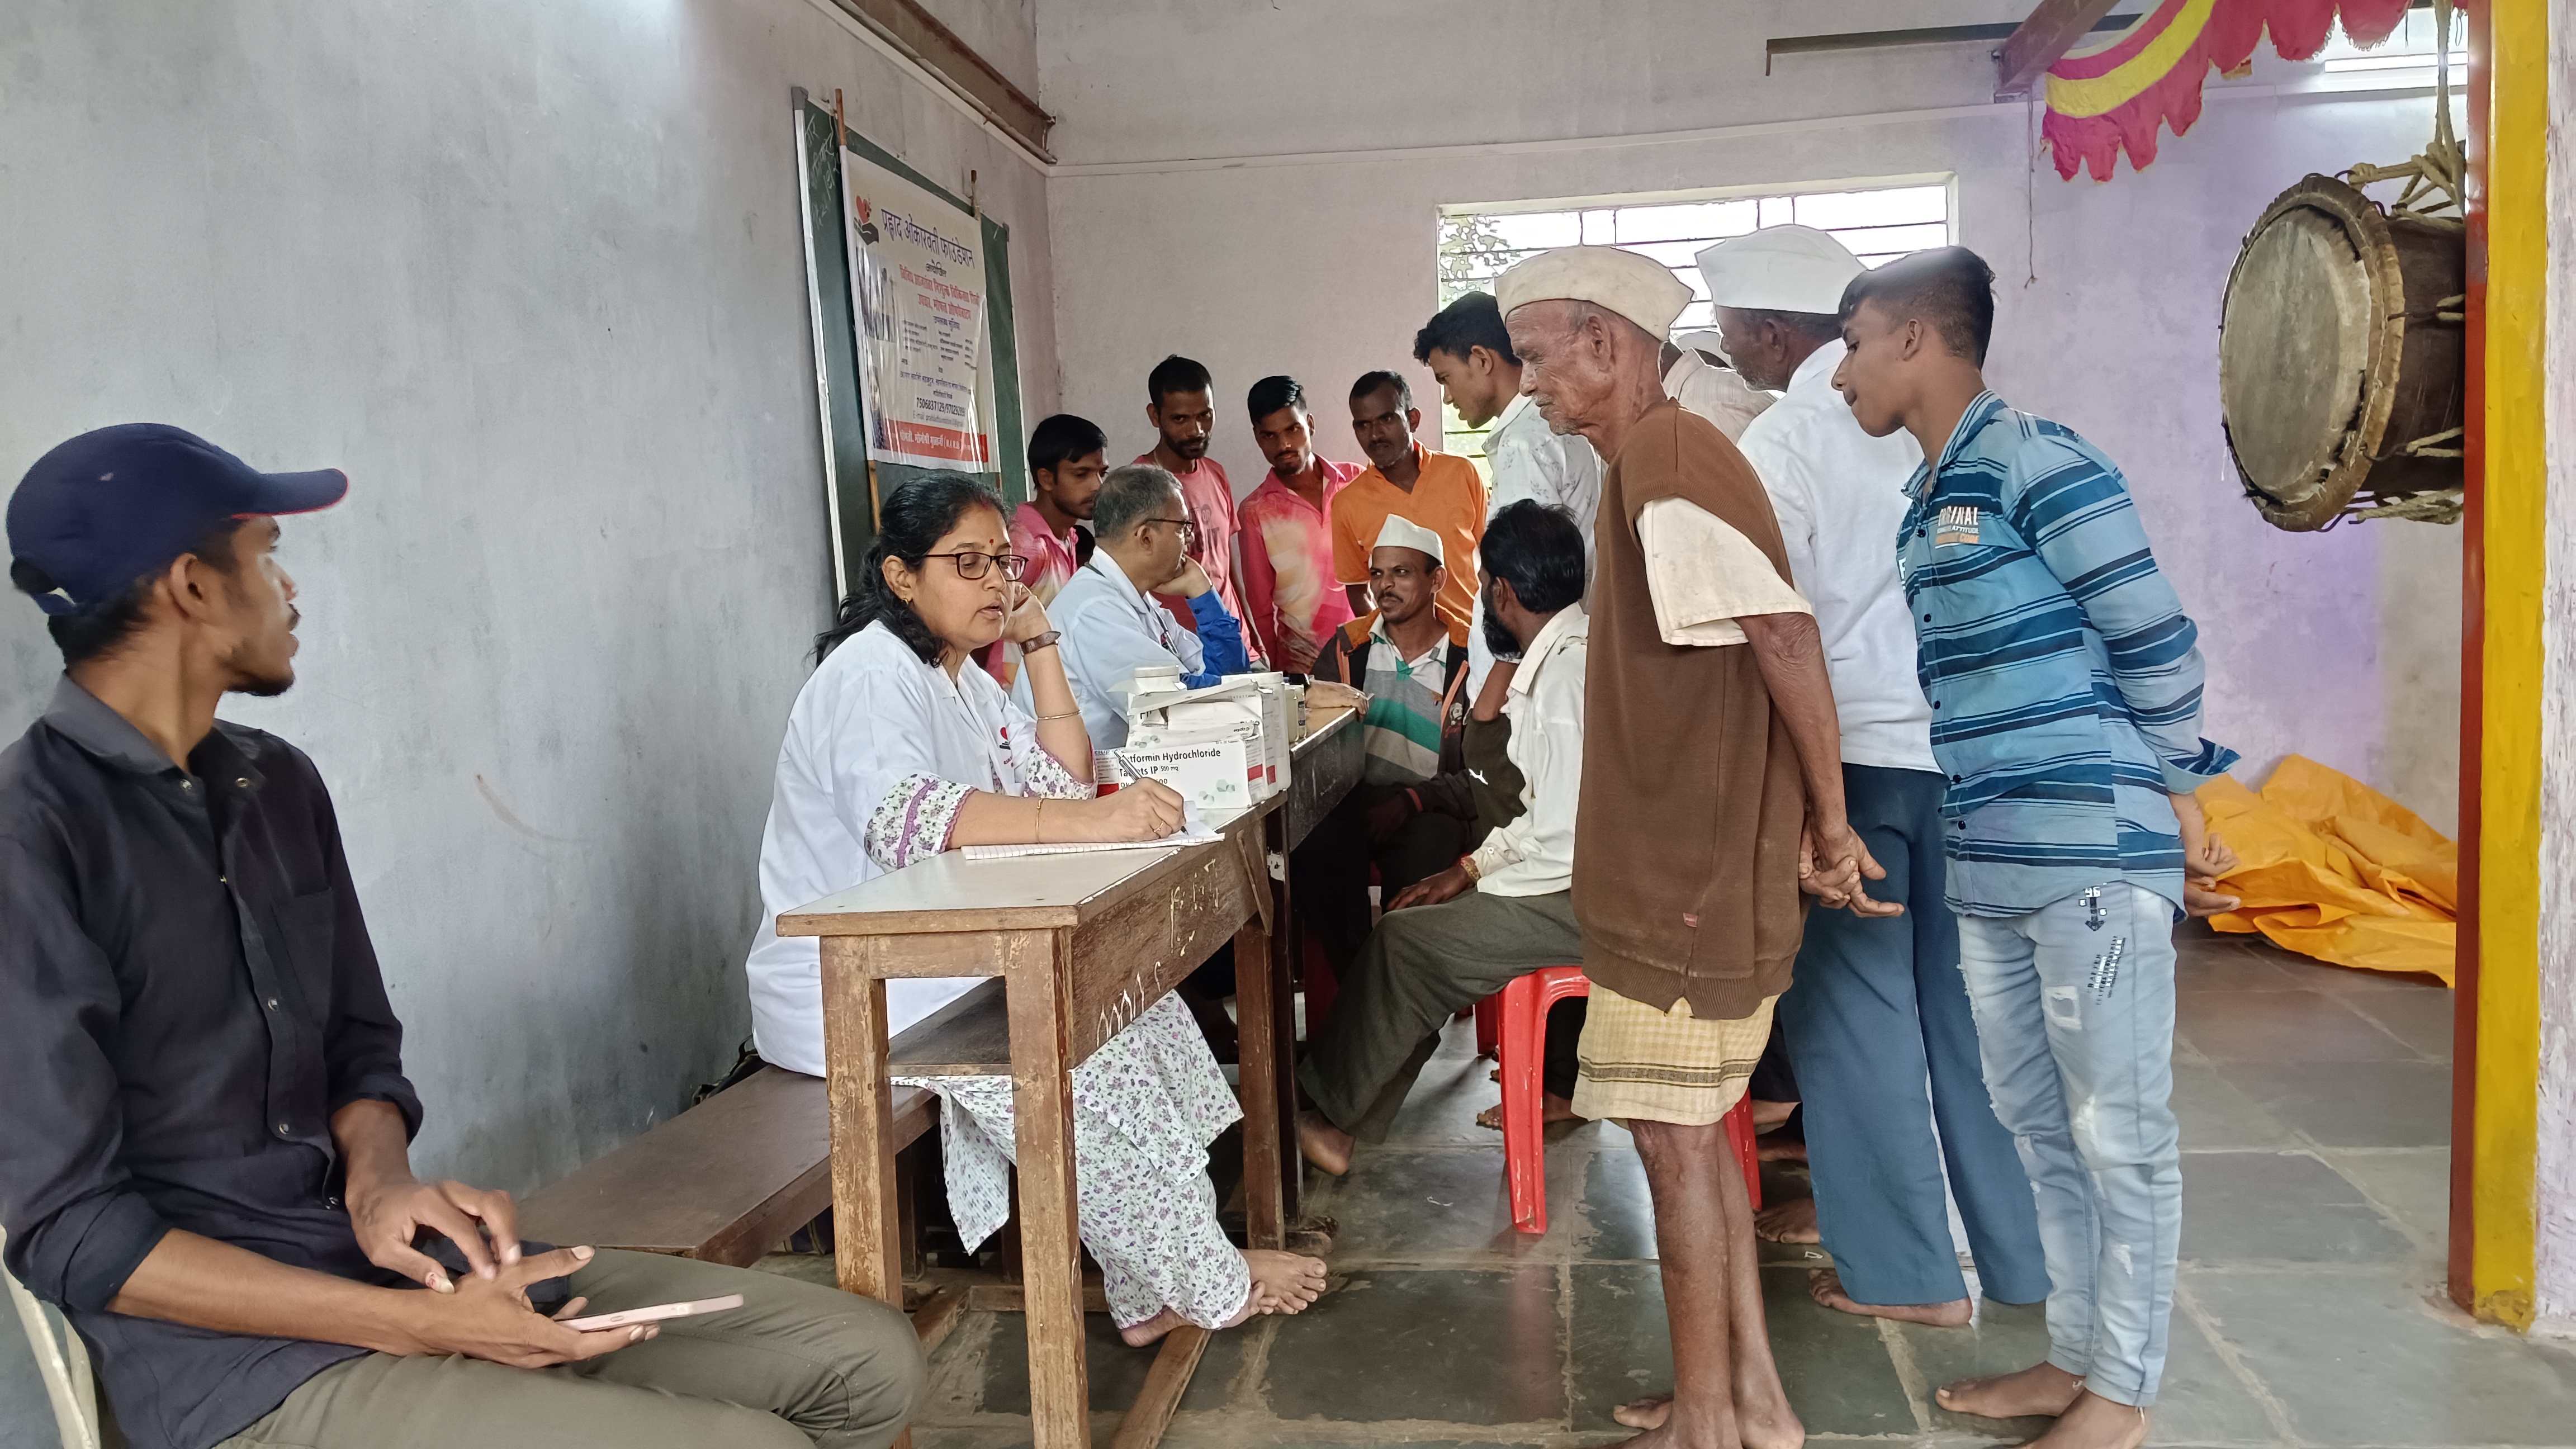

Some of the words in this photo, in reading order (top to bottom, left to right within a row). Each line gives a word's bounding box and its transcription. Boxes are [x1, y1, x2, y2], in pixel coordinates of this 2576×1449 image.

[1122, 752, 1161, 763] tformin
[1162, 748, 1221, 763] Hydrochloride
[1119, 768, 1148, 777] Tats
[1150, 766, 1158, 774] IP
